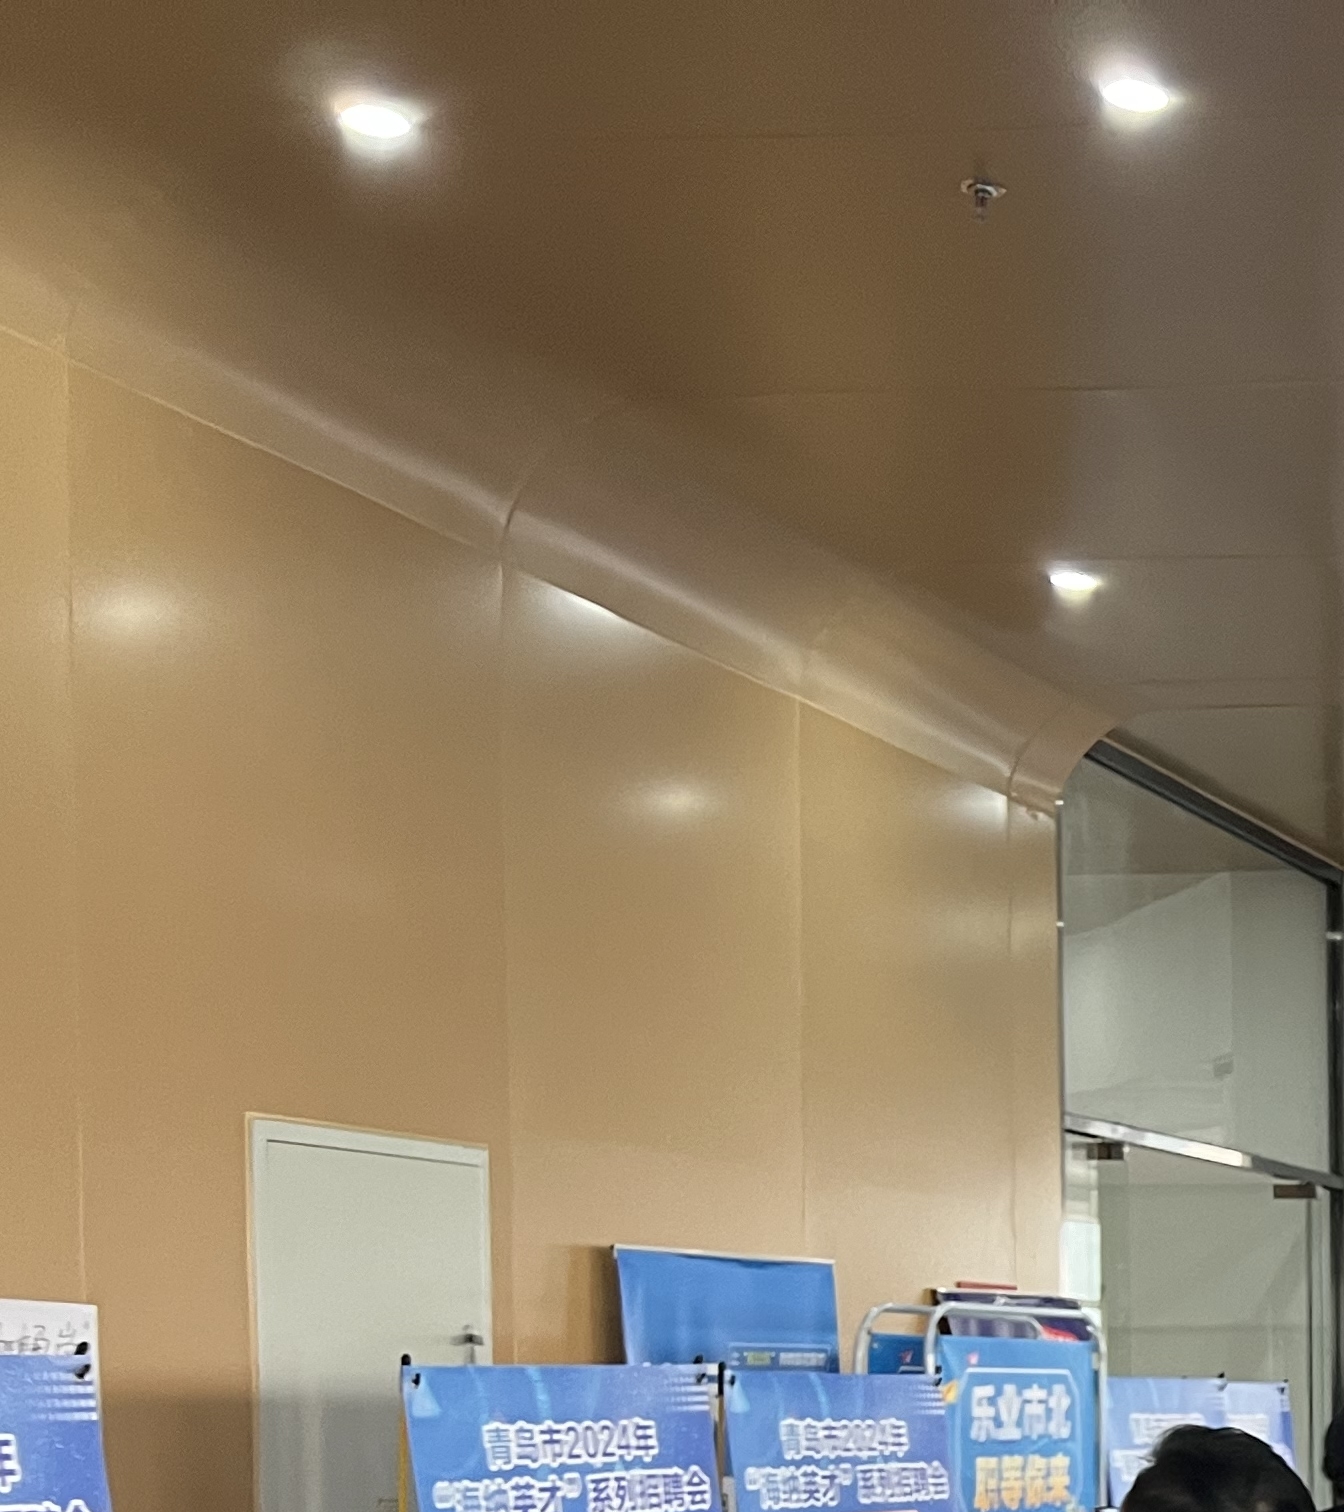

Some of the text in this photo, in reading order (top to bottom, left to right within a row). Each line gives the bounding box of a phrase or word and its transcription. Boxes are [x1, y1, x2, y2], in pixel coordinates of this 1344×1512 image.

[969, 1383, 1072, 1442] 乐业市北
[482, 1417, 660, 1471] 青岛市2024年
[974, 1453, 1071, 1512] 职等你来
